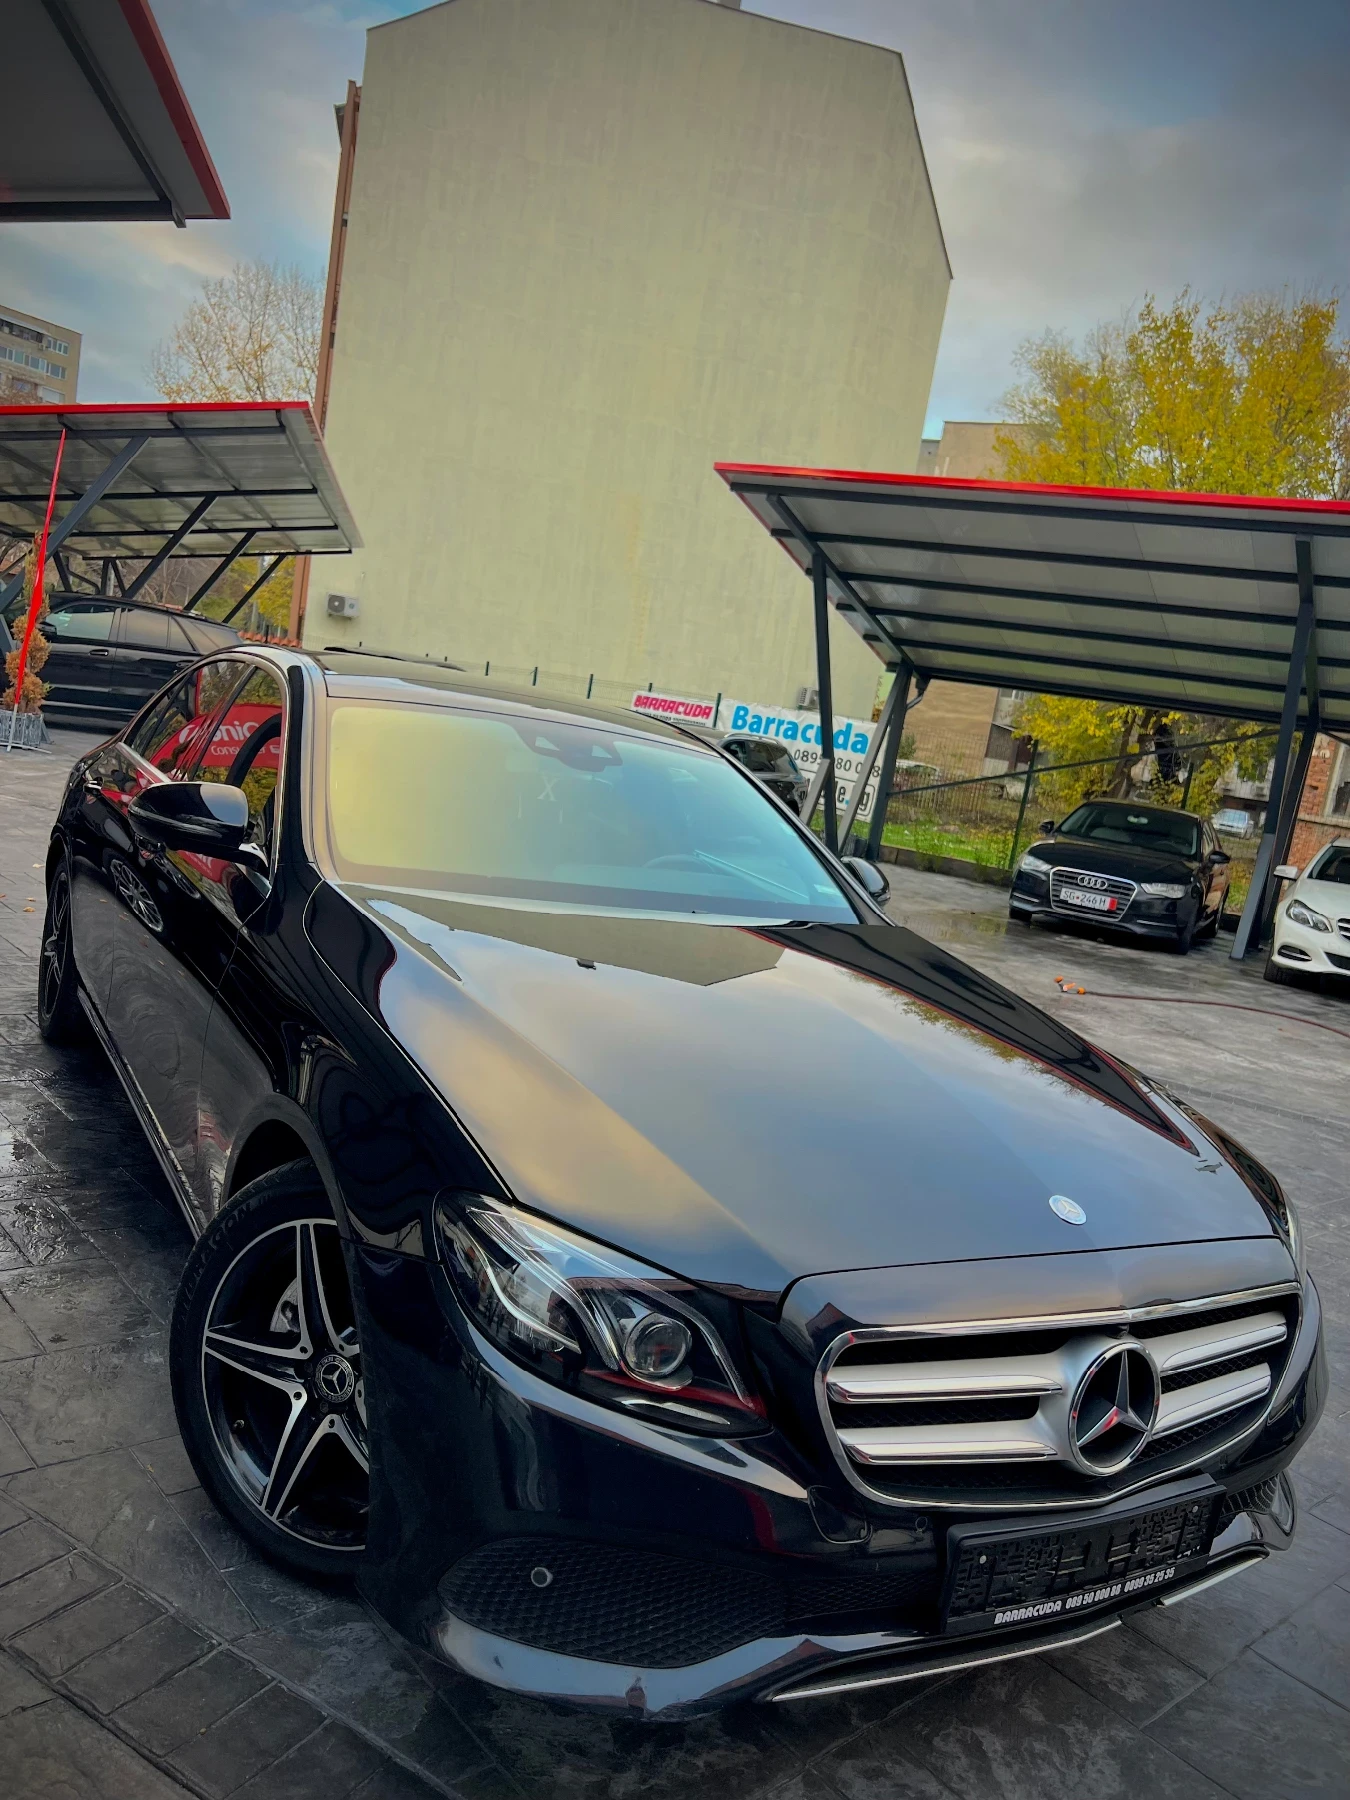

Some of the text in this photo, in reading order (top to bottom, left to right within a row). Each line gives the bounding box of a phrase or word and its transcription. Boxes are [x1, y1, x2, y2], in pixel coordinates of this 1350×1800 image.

[634, 695, 714, 720] BARRACUDA
[855, 762, 881, 778] 08
[993, 1600, 1062, 1625] BARRACUDA
